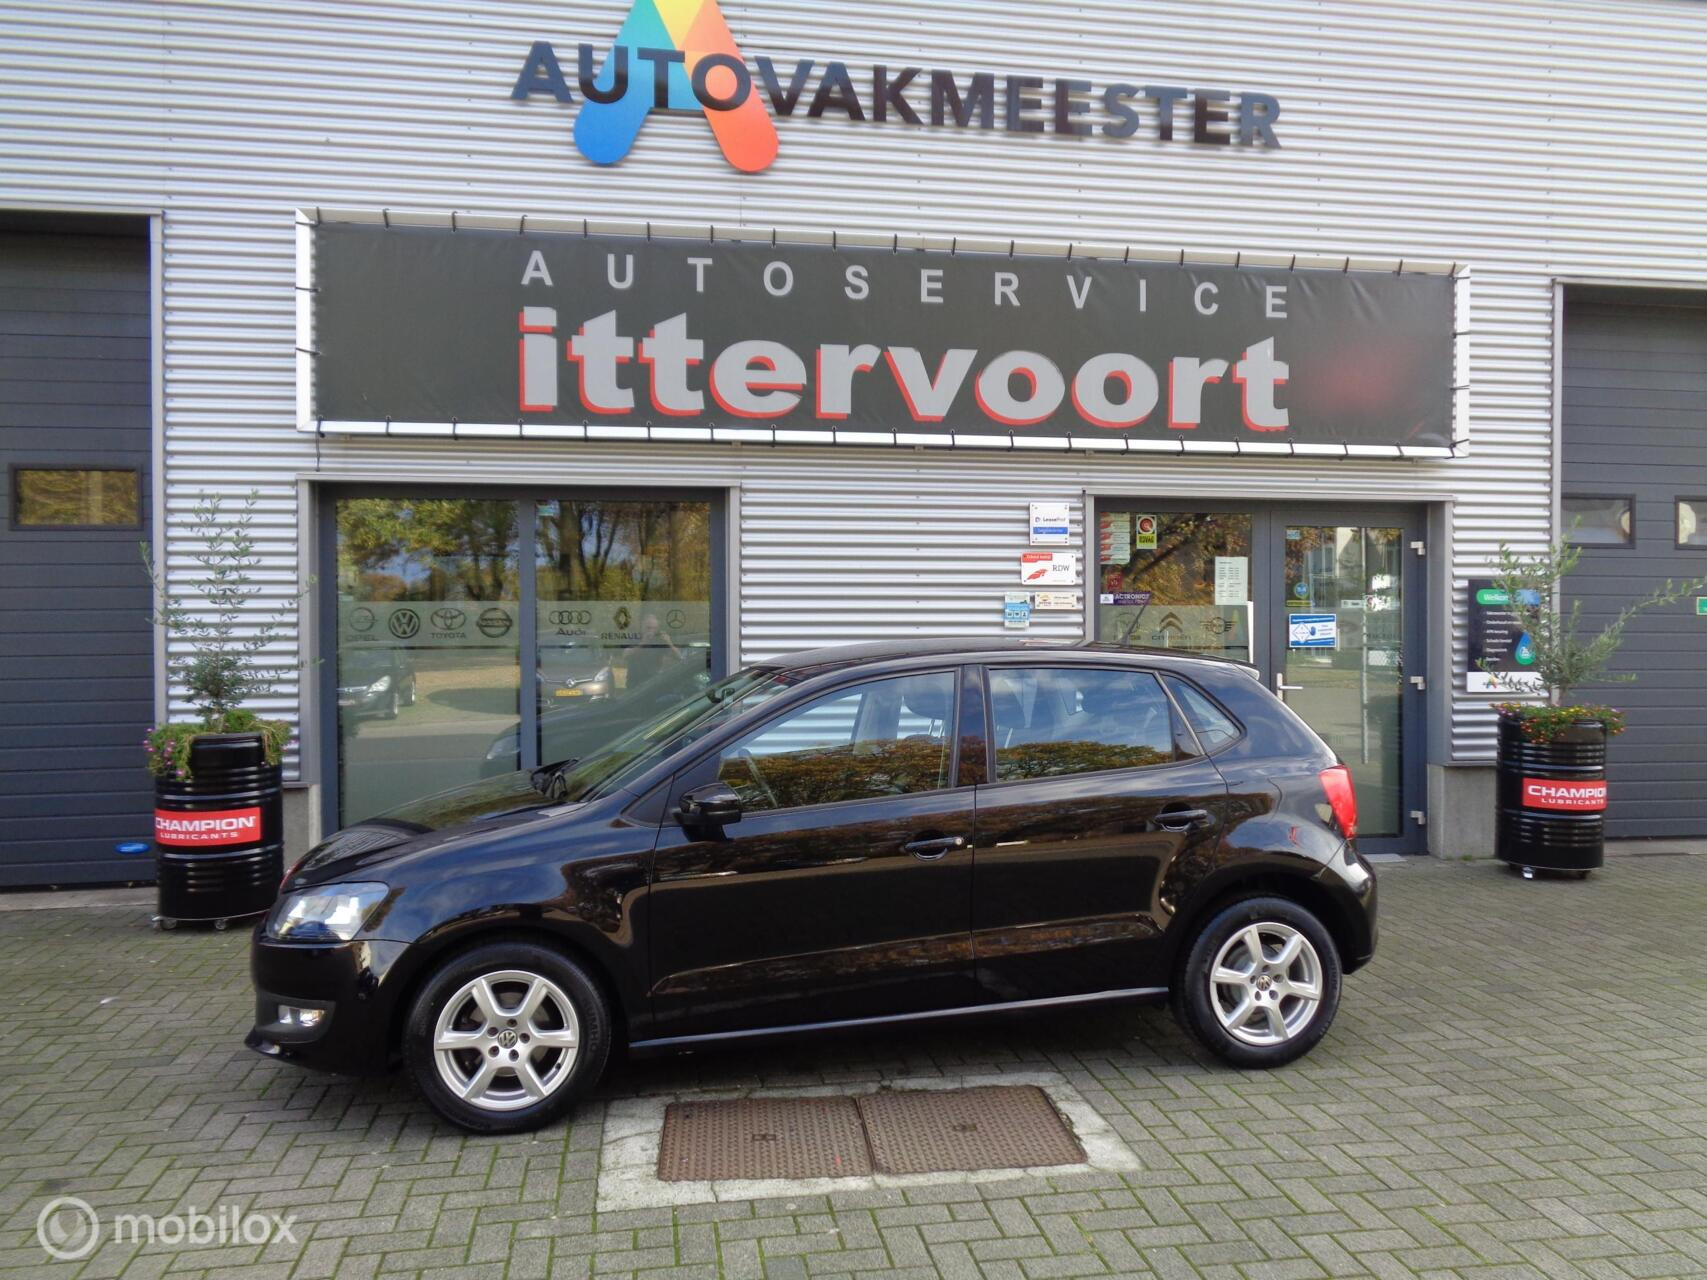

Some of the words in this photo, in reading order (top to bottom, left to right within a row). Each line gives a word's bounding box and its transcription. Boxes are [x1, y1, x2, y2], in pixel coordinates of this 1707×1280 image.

[510, 40, 1282, 149] AUTOVAKMEESTER
[518, 306, 1290, 434] ittervoort
[1053, 564, 1070, 572] RDW
[556, 627, 586, 636] Audi
[601, 632, 641, 640] RENAUL
[1528, 785, 1607, 798] CHAMPIO
[155, 815, 257, 832] CHAMPION
[160, 831, 239, 840] LUBRICANTS
